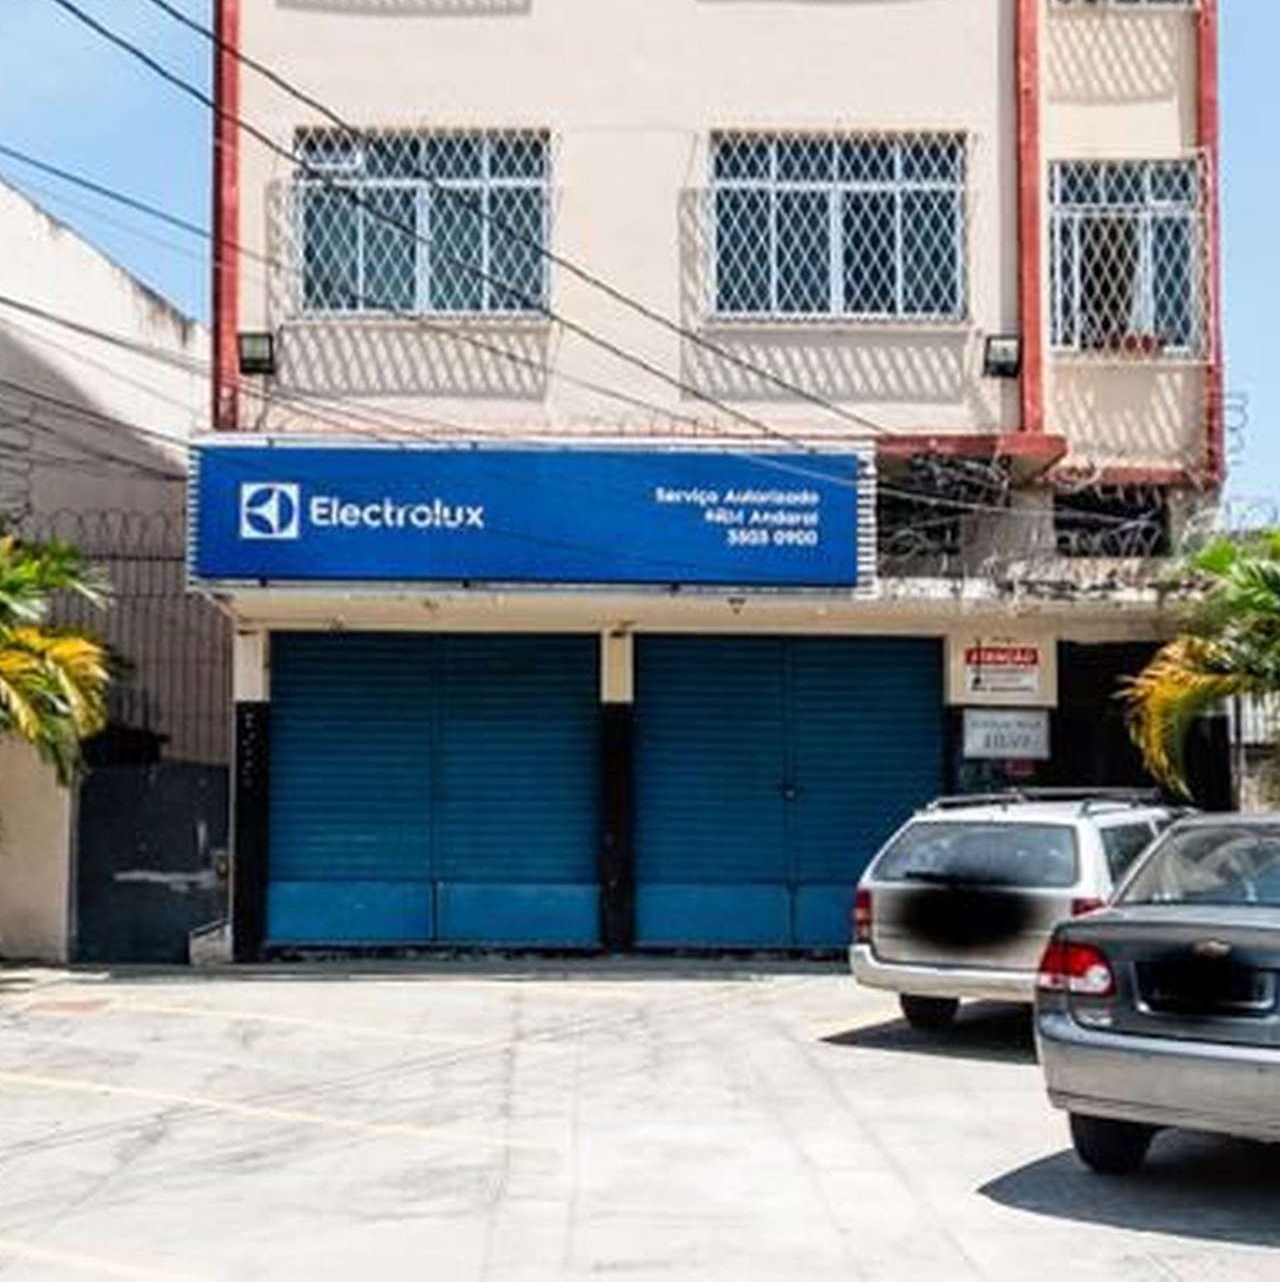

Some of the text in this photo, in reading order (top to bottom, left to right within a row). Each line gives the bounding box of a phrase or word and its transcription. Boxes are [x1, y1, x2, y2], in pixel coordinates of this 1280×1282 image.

[656, 487, 819, 506] Serviço Autorizado
[310, 497, 484, 528] Electrolux
